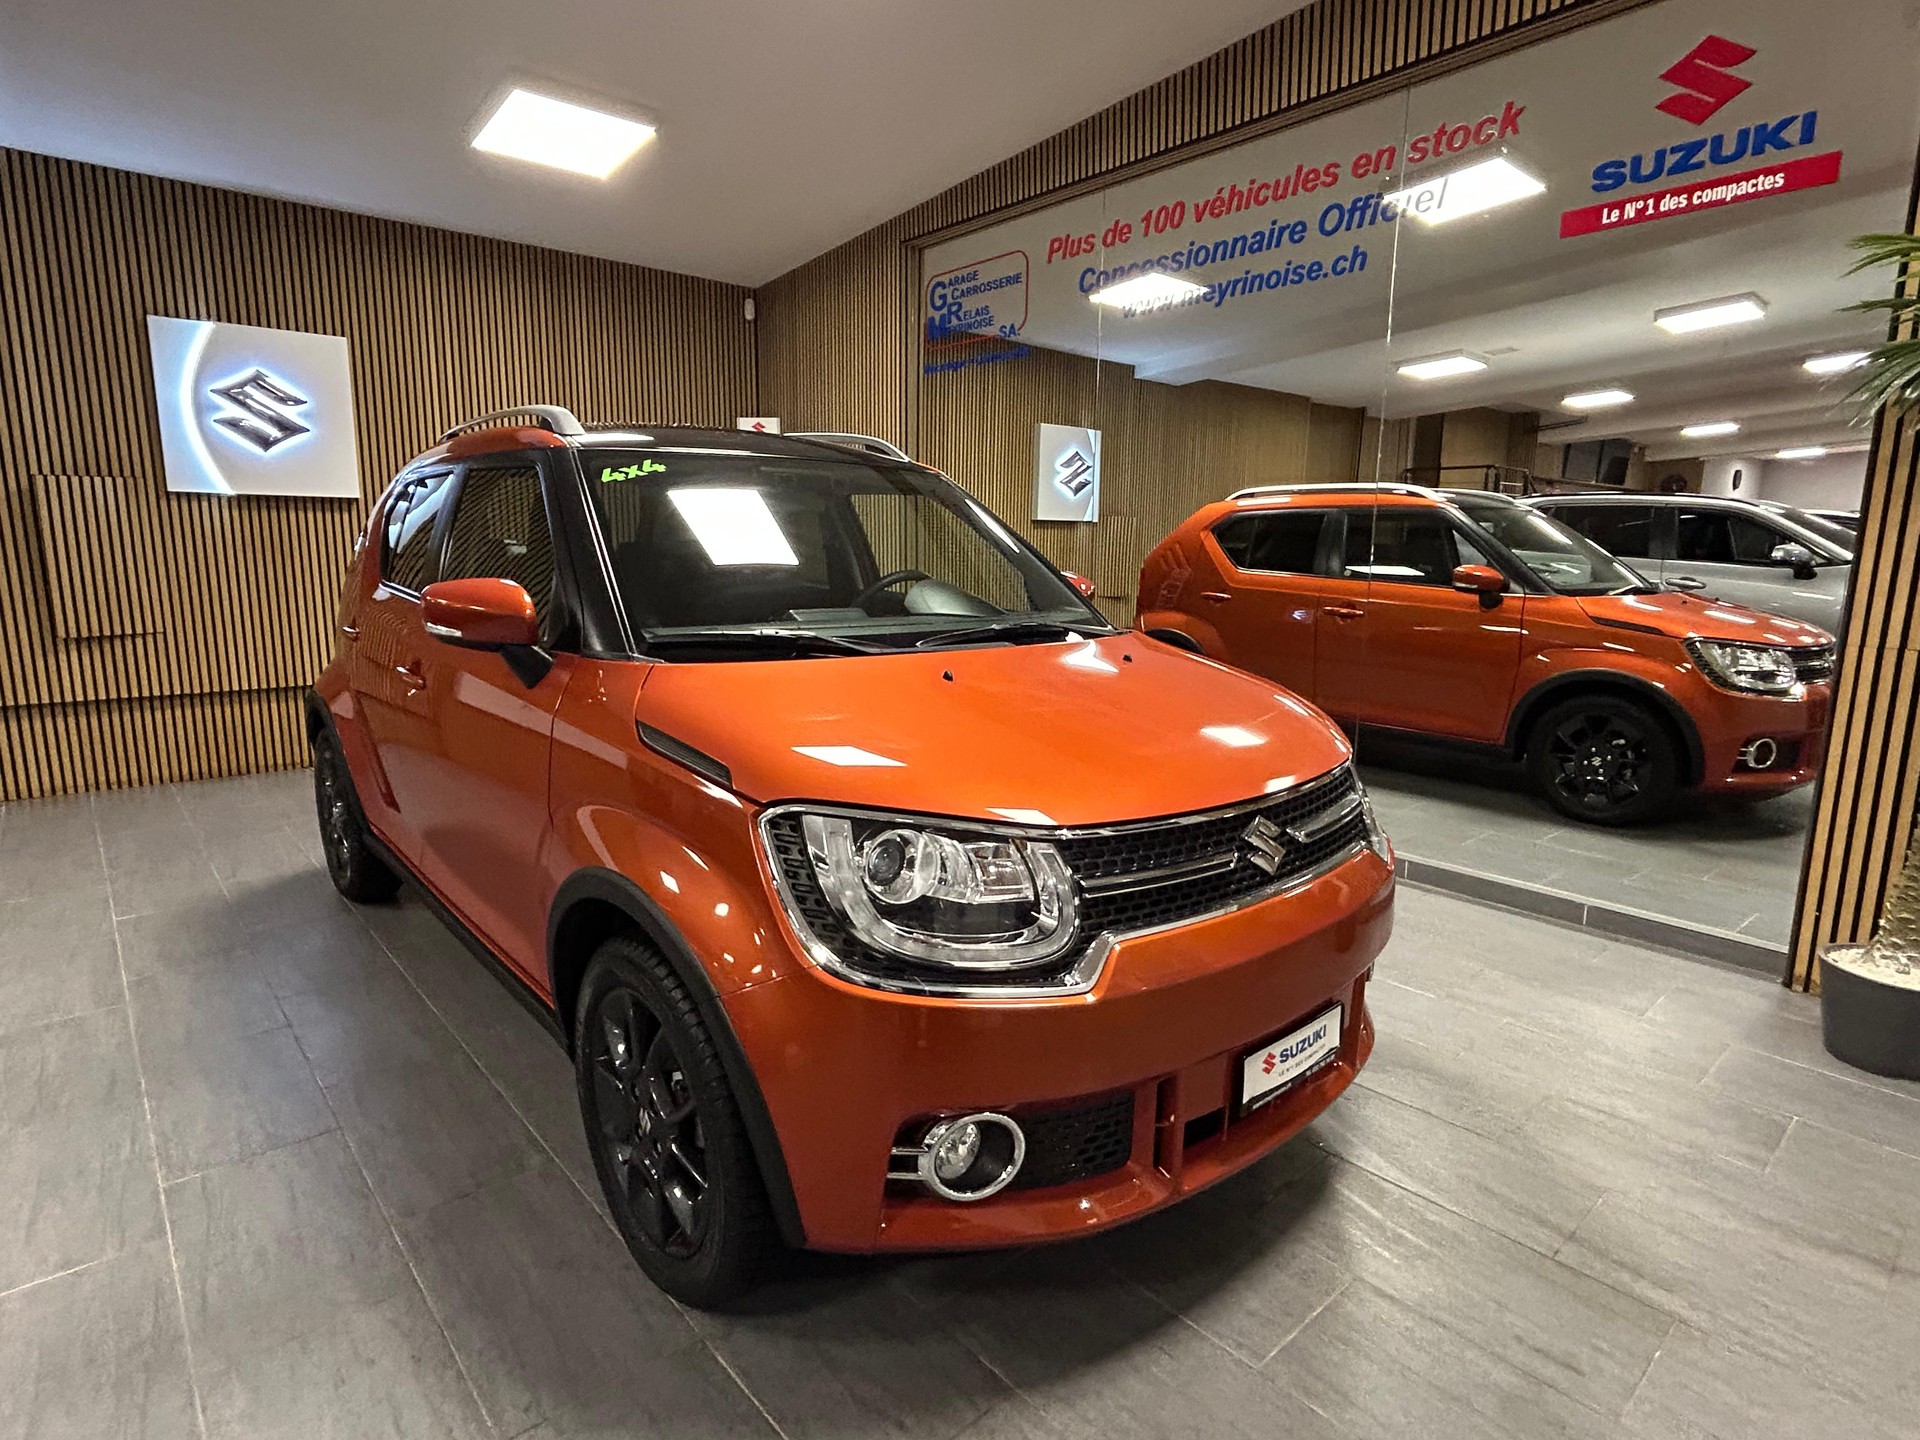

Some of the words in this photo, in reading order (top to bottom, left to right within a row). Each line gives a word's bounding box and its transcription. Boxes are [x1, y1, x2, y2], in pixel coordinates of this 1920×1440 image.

[1591, 111, 1818, 193] SUZUKI
[1046, 232, 1096, 264] Plus
[1101, 219, 1133, 249] de
[1141, 200, 1187, 238] 100
[1192, 161, 1341, 224] véhicules
[1350, 145, 1397, 180] en
[1407, 101, 1527, 165] stock
[1602, 207, 1620, 225] Le
[1659, 193, 1688, 212] des
[1692, 172, 1785, 206] compactes
[1318, 177, 1448, 237] Officiel
[929, 270, 979, 311] GARAGE
[951, 272, 1022, 301] CARROSSERIE
[947, 300, 991, 325] RELAIS
[1279, 1024, 1327, 1063] SUZUKI
